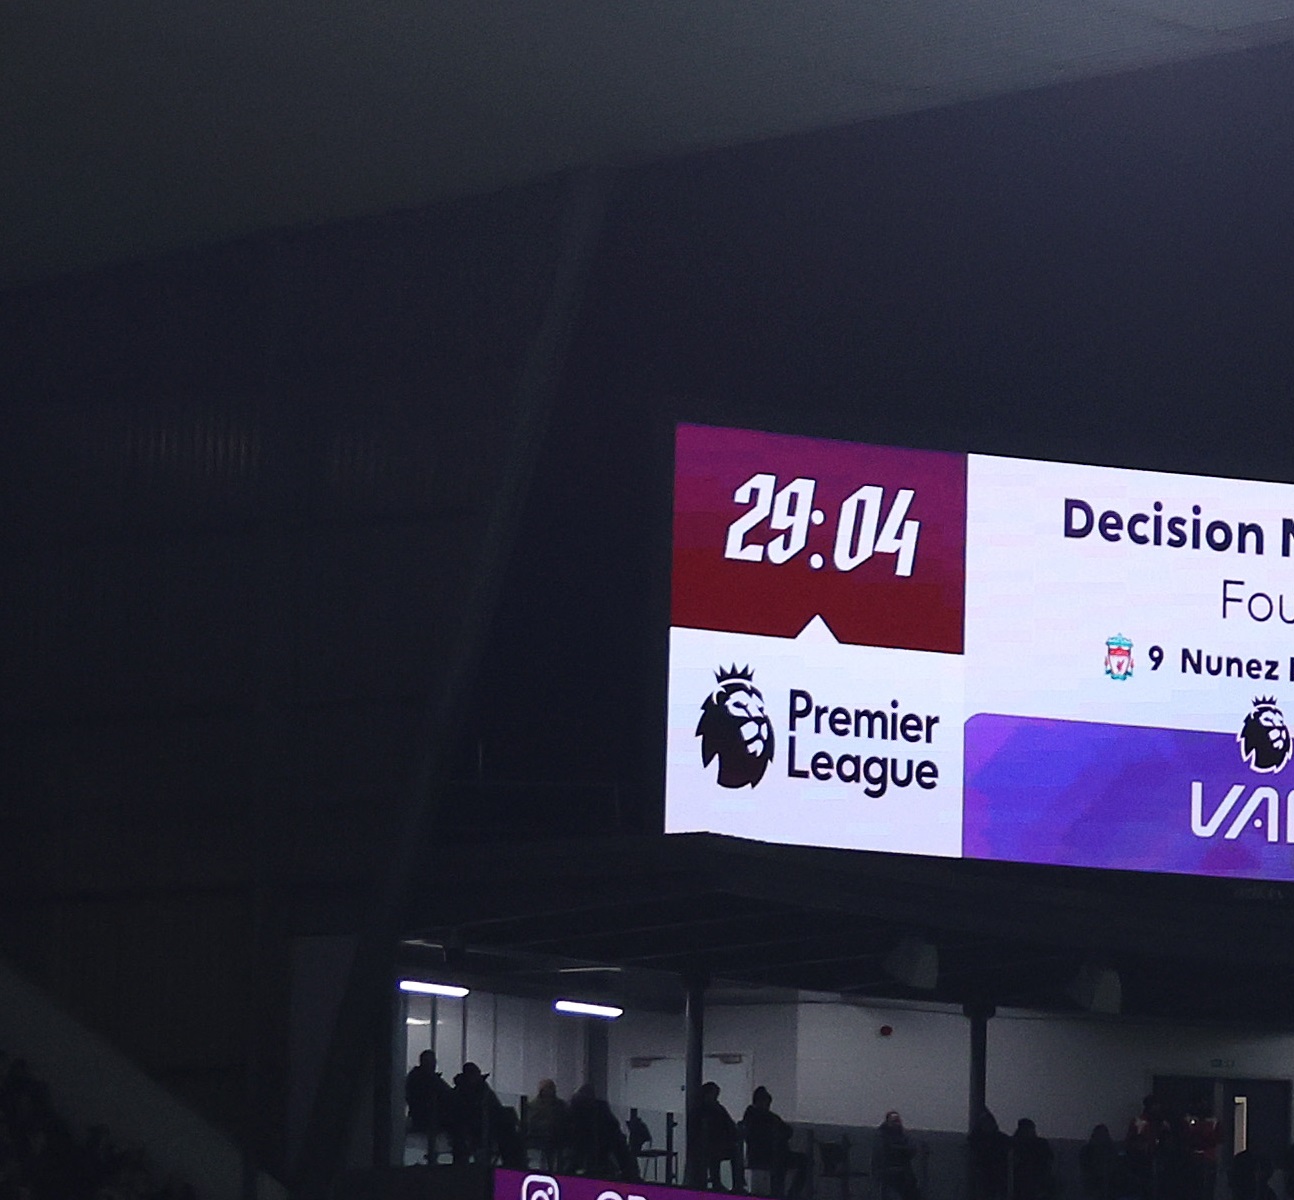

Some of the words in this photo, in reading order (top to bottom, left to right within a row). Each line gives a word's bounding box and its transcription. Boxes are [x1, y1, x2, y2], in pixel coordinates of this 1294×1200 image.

[724, 473, 920, 577] 29:04
[1064, 497, 1264, 555] Decision
[1148, 645, 1164, 671] 9
[1181, 648, 1279, 681] Nunez
[787, 688, 941, 745] Premier
[787, 732, 940, 799] League
